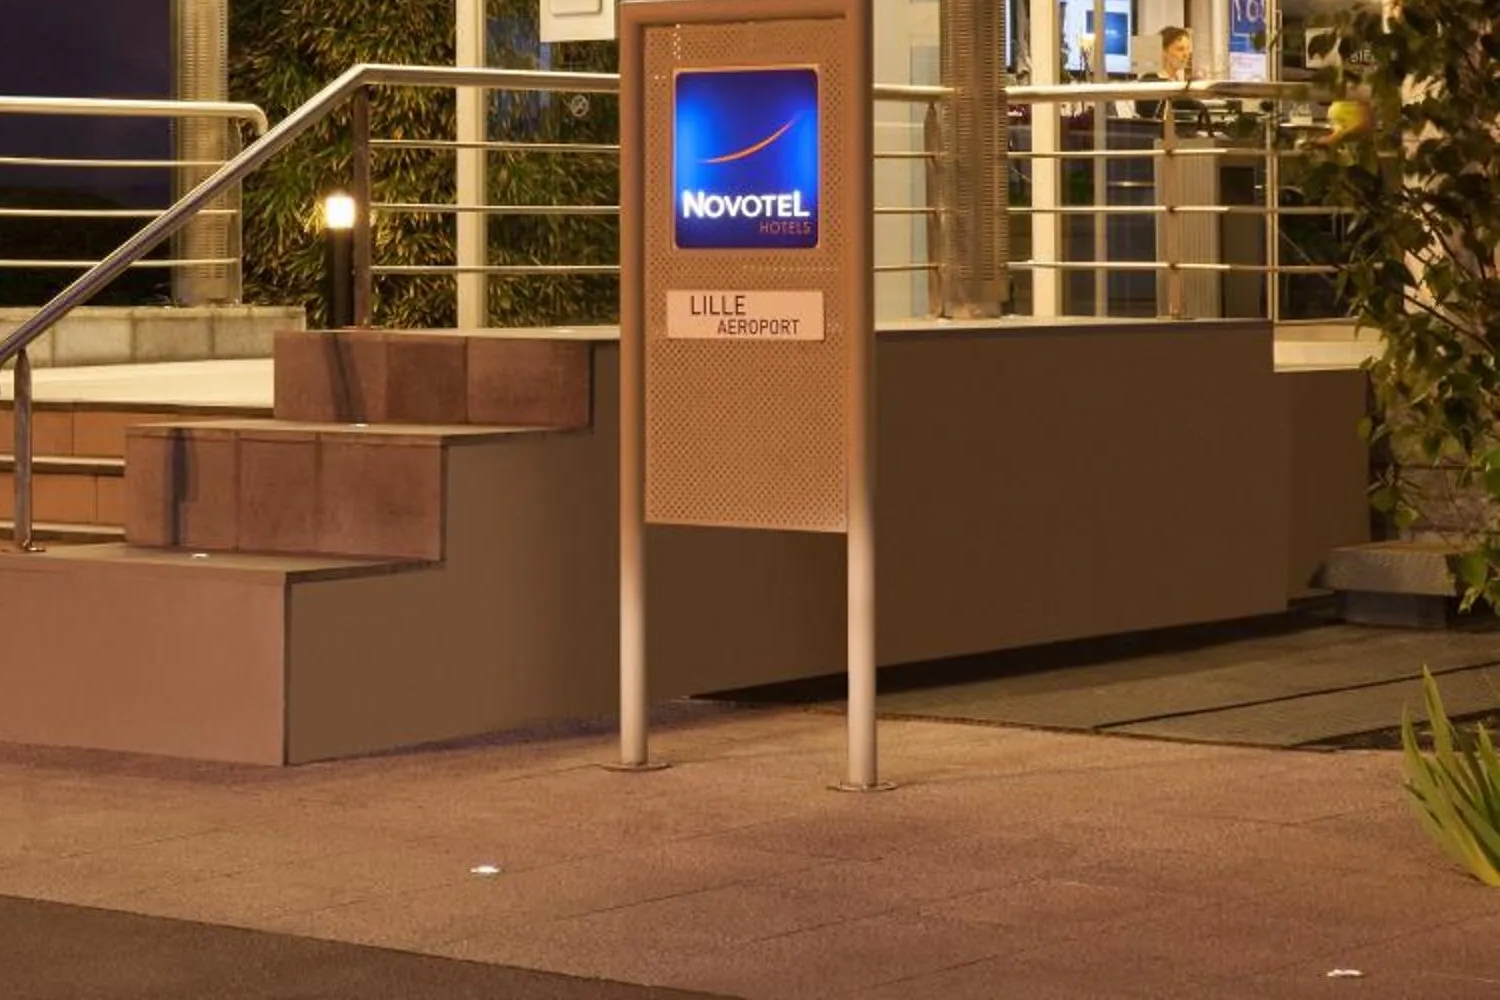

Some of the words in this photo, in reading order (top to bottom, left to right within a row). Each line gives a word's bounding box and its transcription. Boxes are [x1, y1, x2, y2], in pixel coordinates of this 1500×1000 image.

[681, 189, 811, 218] NOVOTEL
[759, 220, 811, 235] HOTELS
[690, 295, 747, 316] LILLE
[716, 318, 801, 336] AEROPORT
